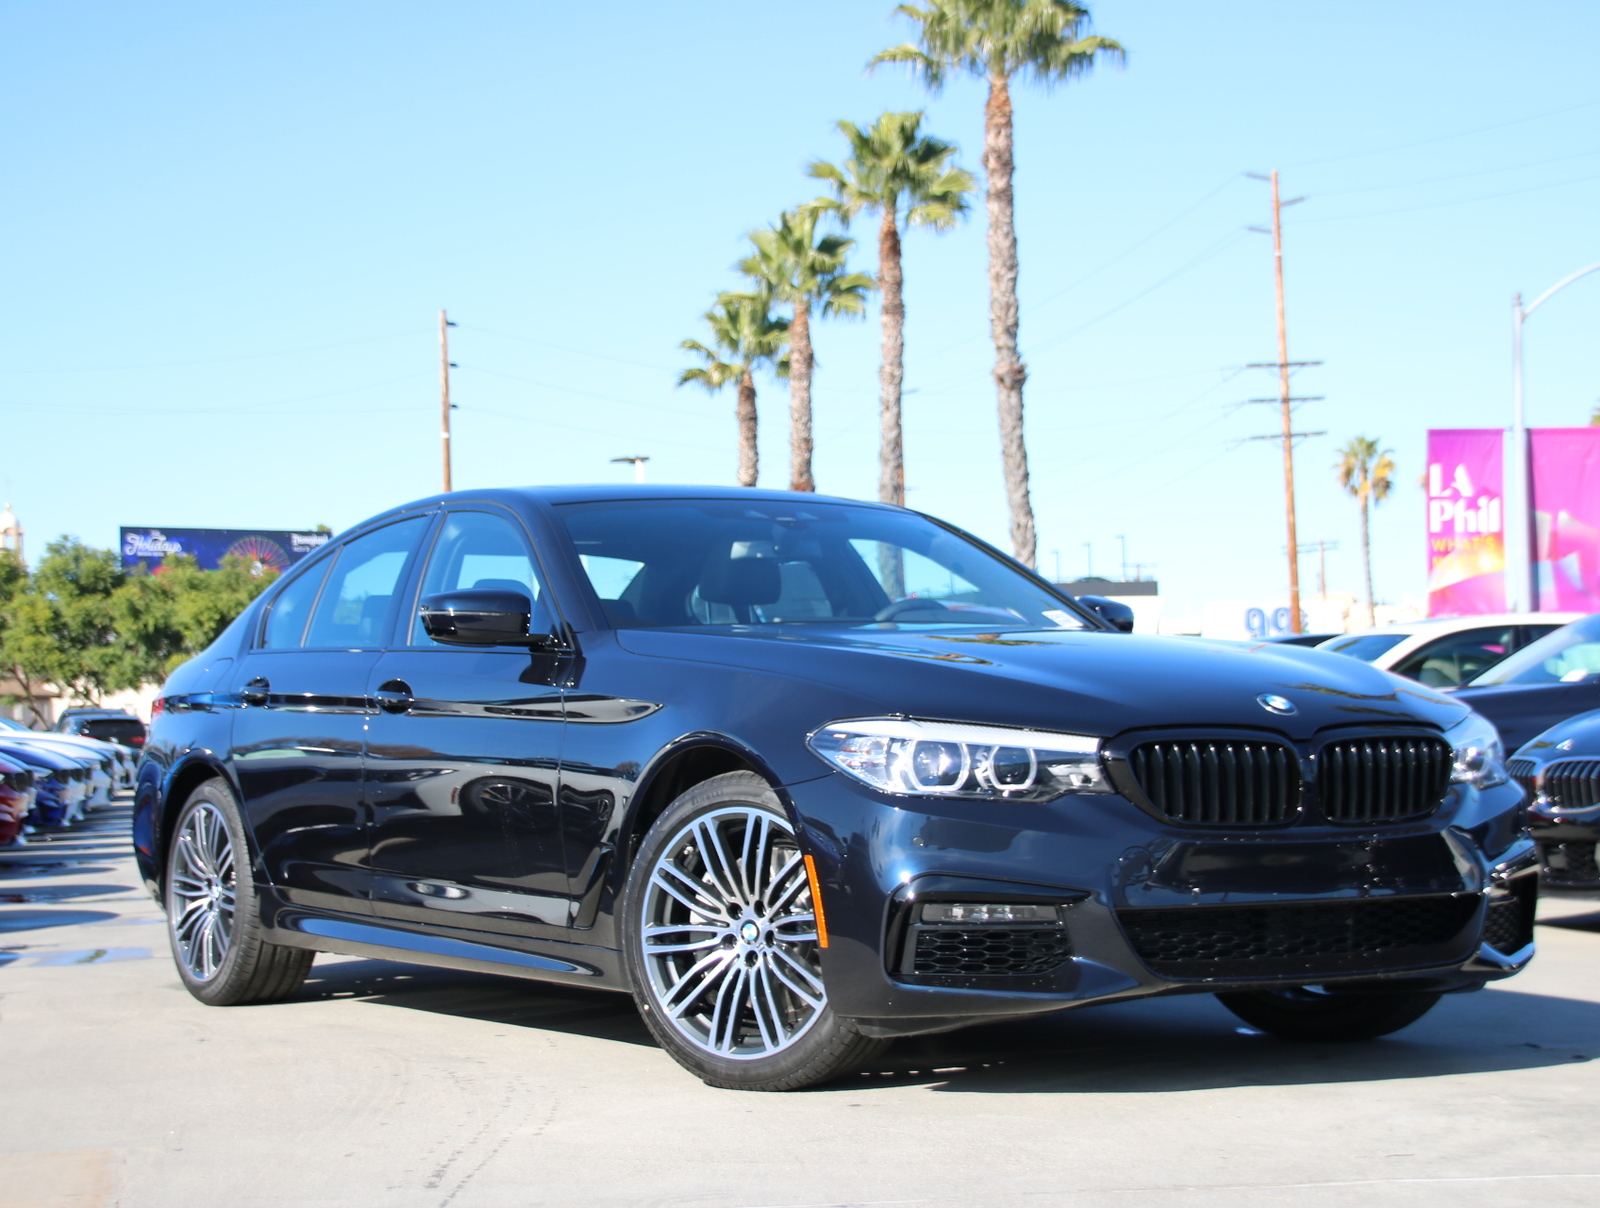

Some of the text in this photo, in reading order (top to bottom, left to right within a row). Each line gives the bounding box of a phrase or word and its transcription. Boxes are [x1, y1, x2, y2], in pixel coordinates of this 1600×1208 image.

[1429, 463, 1474, 497] LA
[1429, 496, 1501, 533] Phil
[1431, 535, 1496, 553] WHAT'S
